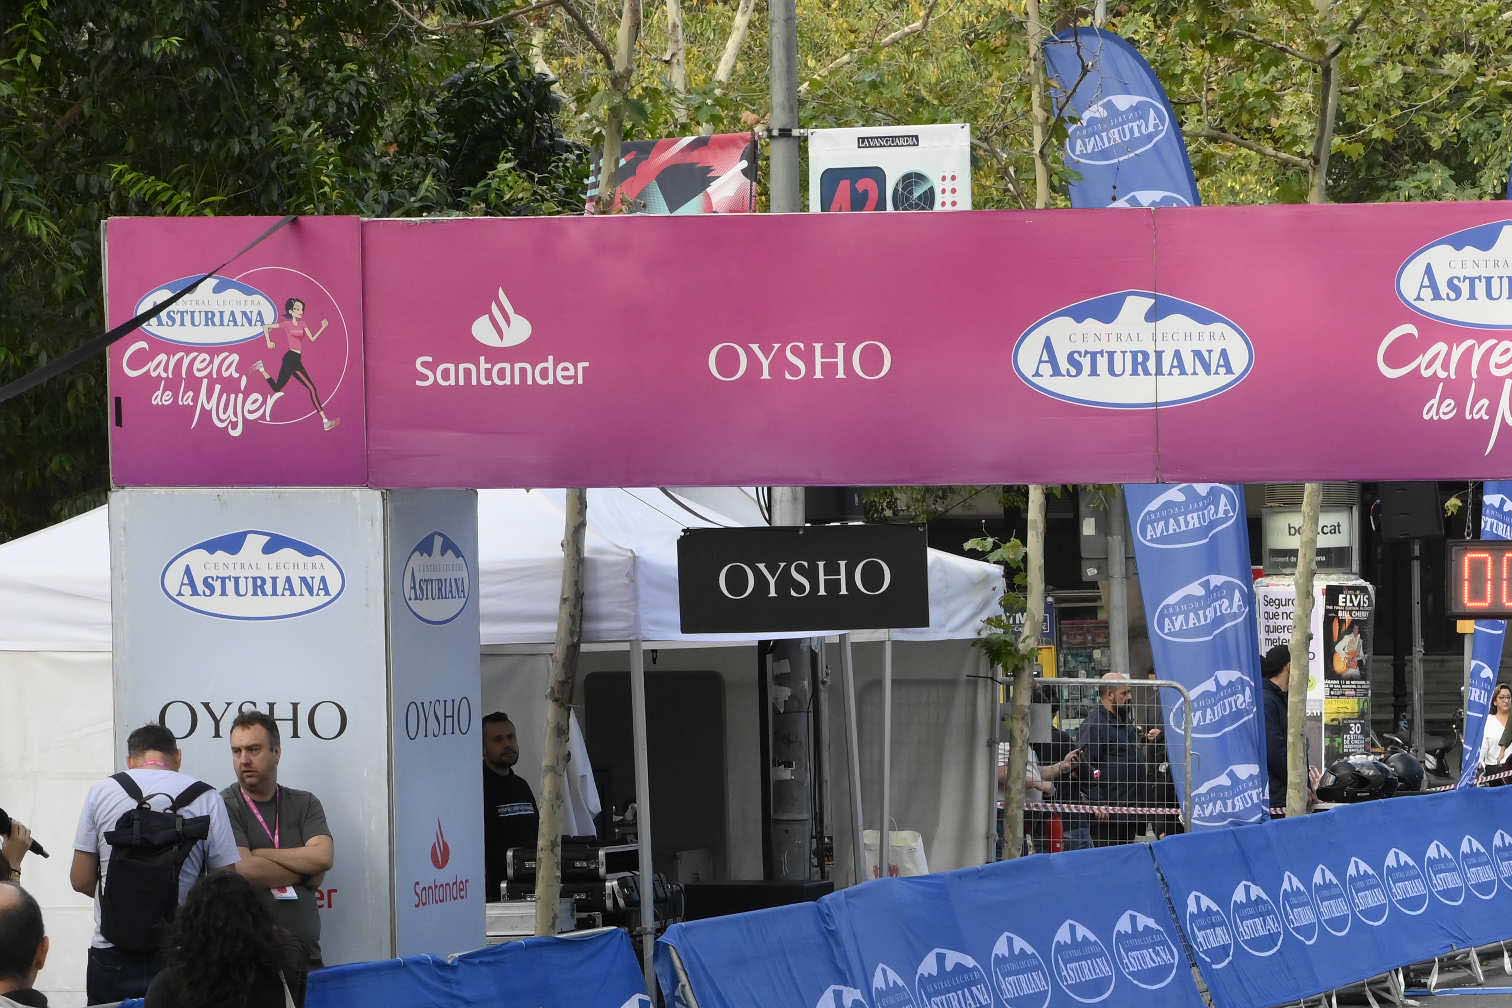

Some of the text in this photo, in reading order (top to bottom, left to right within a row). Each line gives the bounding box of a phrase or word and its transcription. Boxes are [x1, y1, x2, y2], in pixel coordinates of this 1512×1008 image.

[1068, 332, 1143, 344] CENTRAL
[122, 341, 240, 378] Carrera
[415, 355, 590, 386] Santander
[707, 341, 892, 382] OYSHO
[1031, 335, 1235, 378] ASTURIANA
[152, 375, 285, 436] de la Mujer
[1422, 388, 1457, 422] de
[1465, 382, 1490, 421] la
[175, 563, 333, 598] ASTURIANA
[204, 560, 326, 571] CENTRAL LECHERA
[718, 557, 893, 600] OYSHO
[408, 566, 467, 601] ASTURIANA
[1338, 594, 1369, 607] ELVIS
[1263, 611, 1280, 624] que
[405, 697, 472, 741] OYSHO
[1349, 723, 1361, 734] 30
[413, 875, 469, 909] Santander
